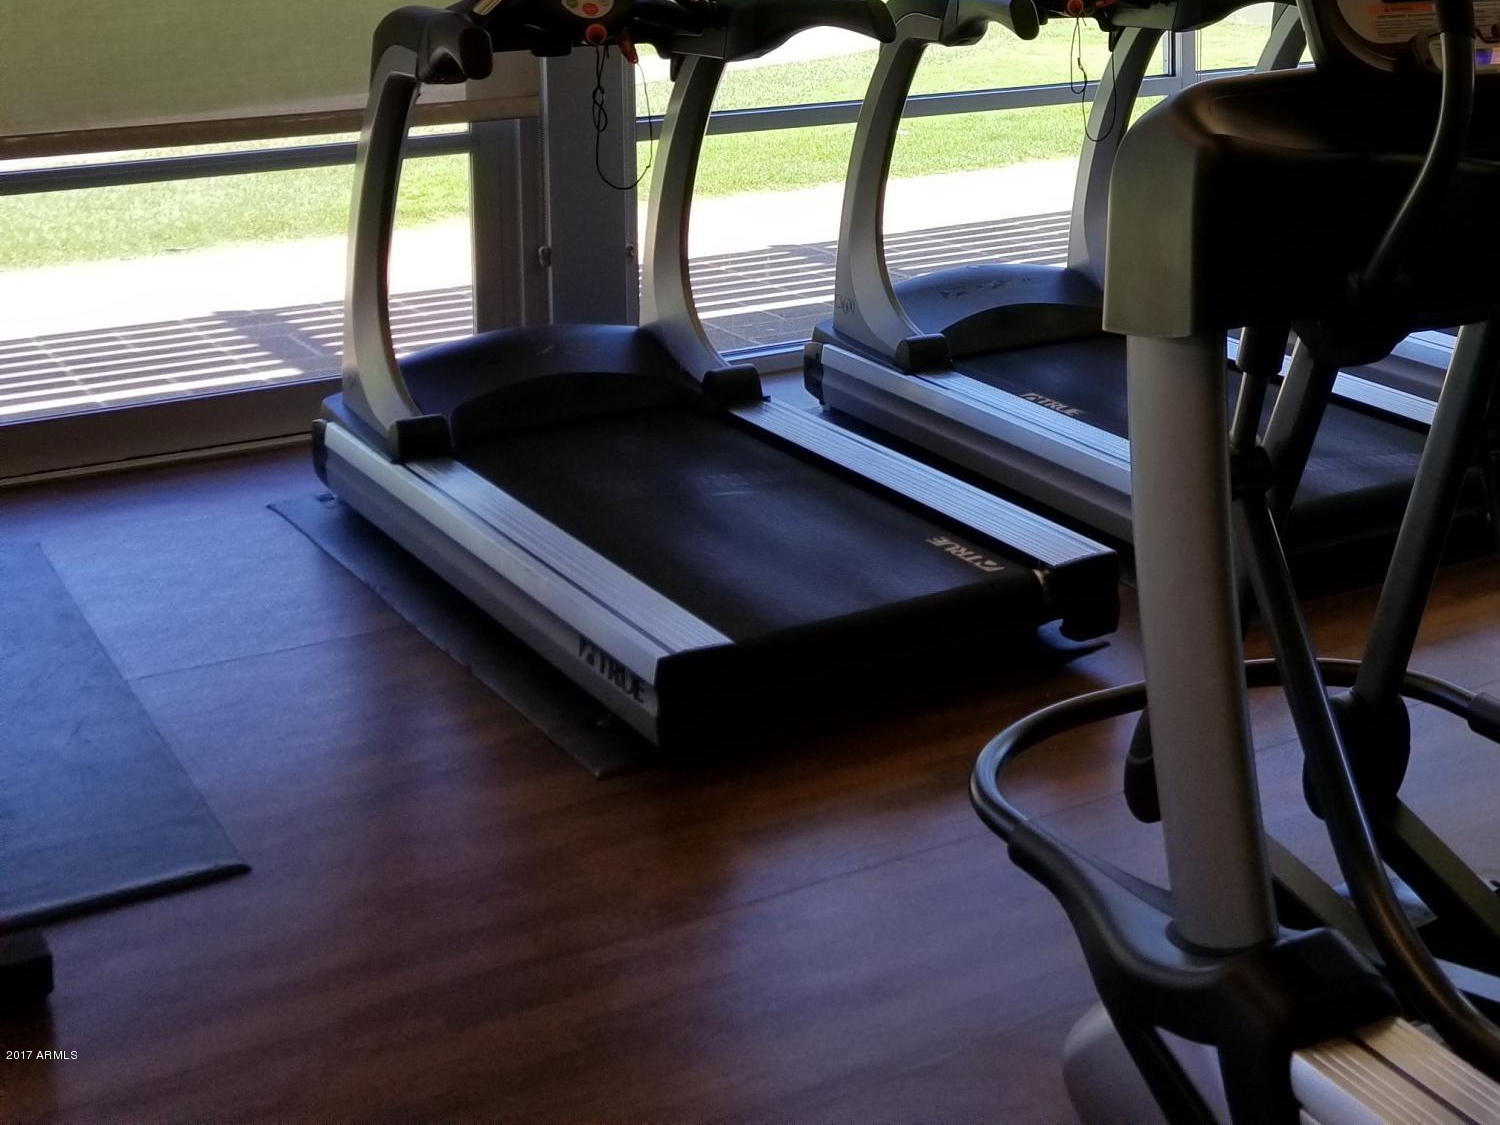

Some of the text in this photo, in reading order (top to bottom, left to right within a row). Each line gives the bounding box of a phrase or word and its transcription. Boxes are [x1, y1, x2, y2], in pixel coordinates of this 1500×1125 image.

[1036, 396, 1086, 417] TRUE
[925, 535, 984, 565] TRUE
[599, 651, 645, 704] TRUE
